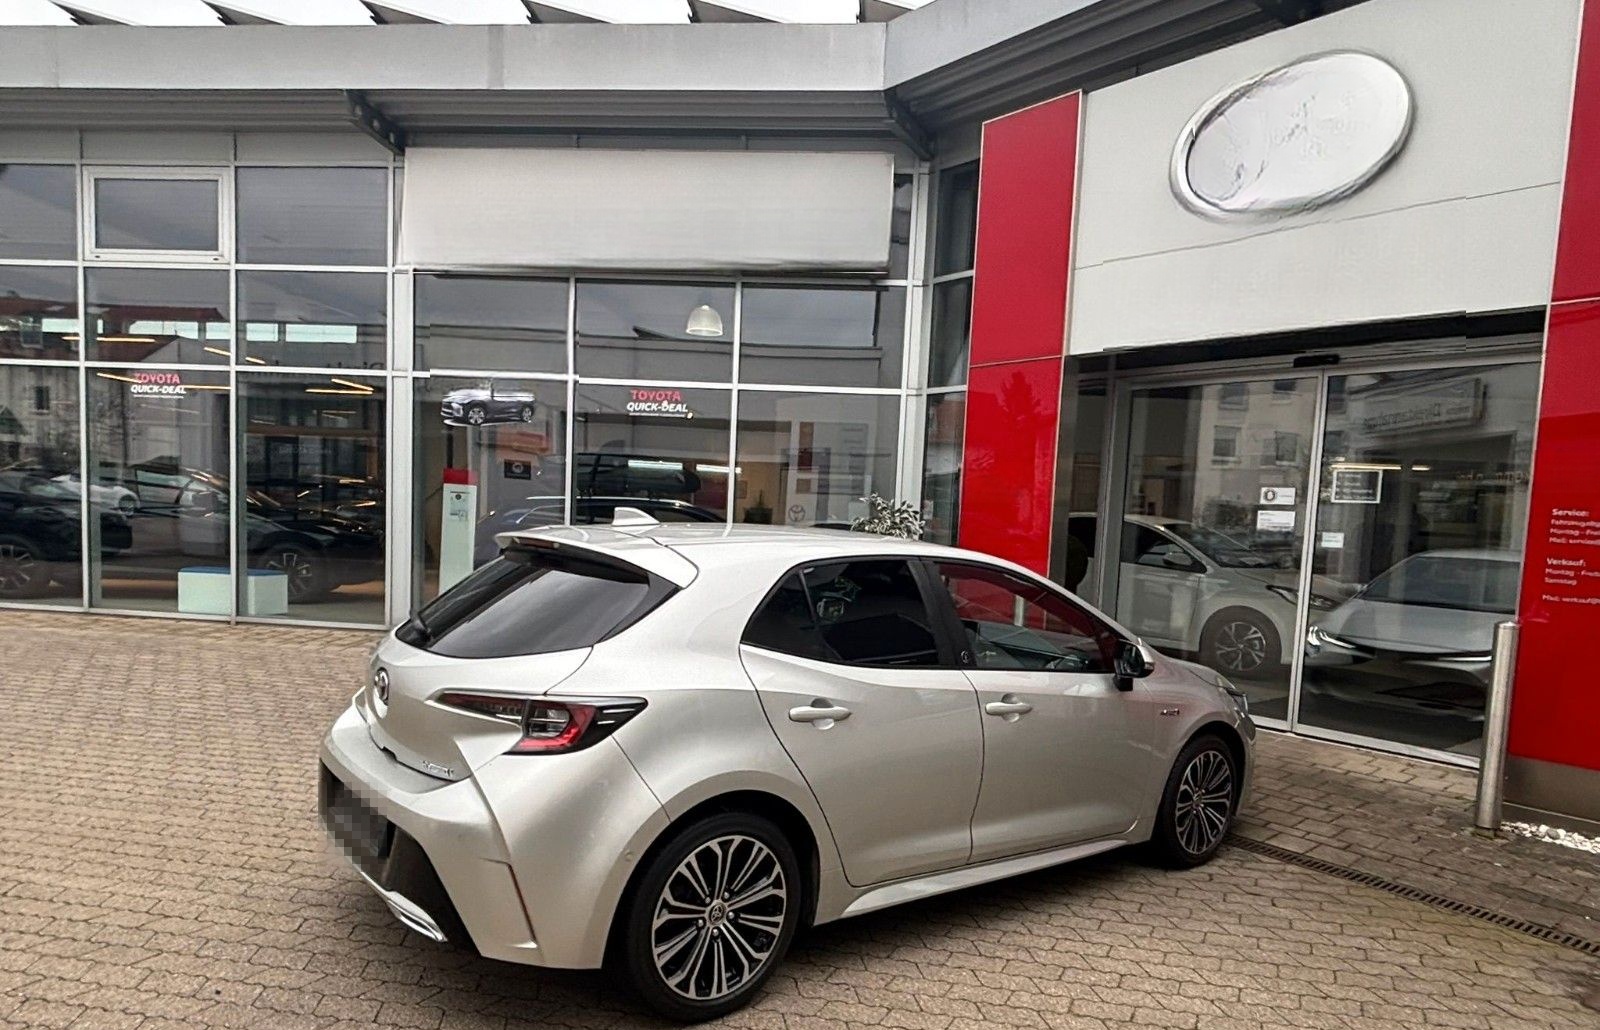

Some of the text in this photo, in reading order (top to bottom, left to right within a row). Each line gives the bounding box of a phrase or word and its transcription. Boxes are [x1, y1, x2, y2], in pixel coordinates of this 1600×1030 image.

[134, 372, 181, 384] TOYOTA
[130, 384, 187, 394] QUICK-DEAL
[630, 389, 682, 401] TOYOTA
[626, 402, 689, 413] QUICK-DEAL
[1552, 508, 1589, 516] Service:
[1547, 558, 1586, 566] Verkauf:
